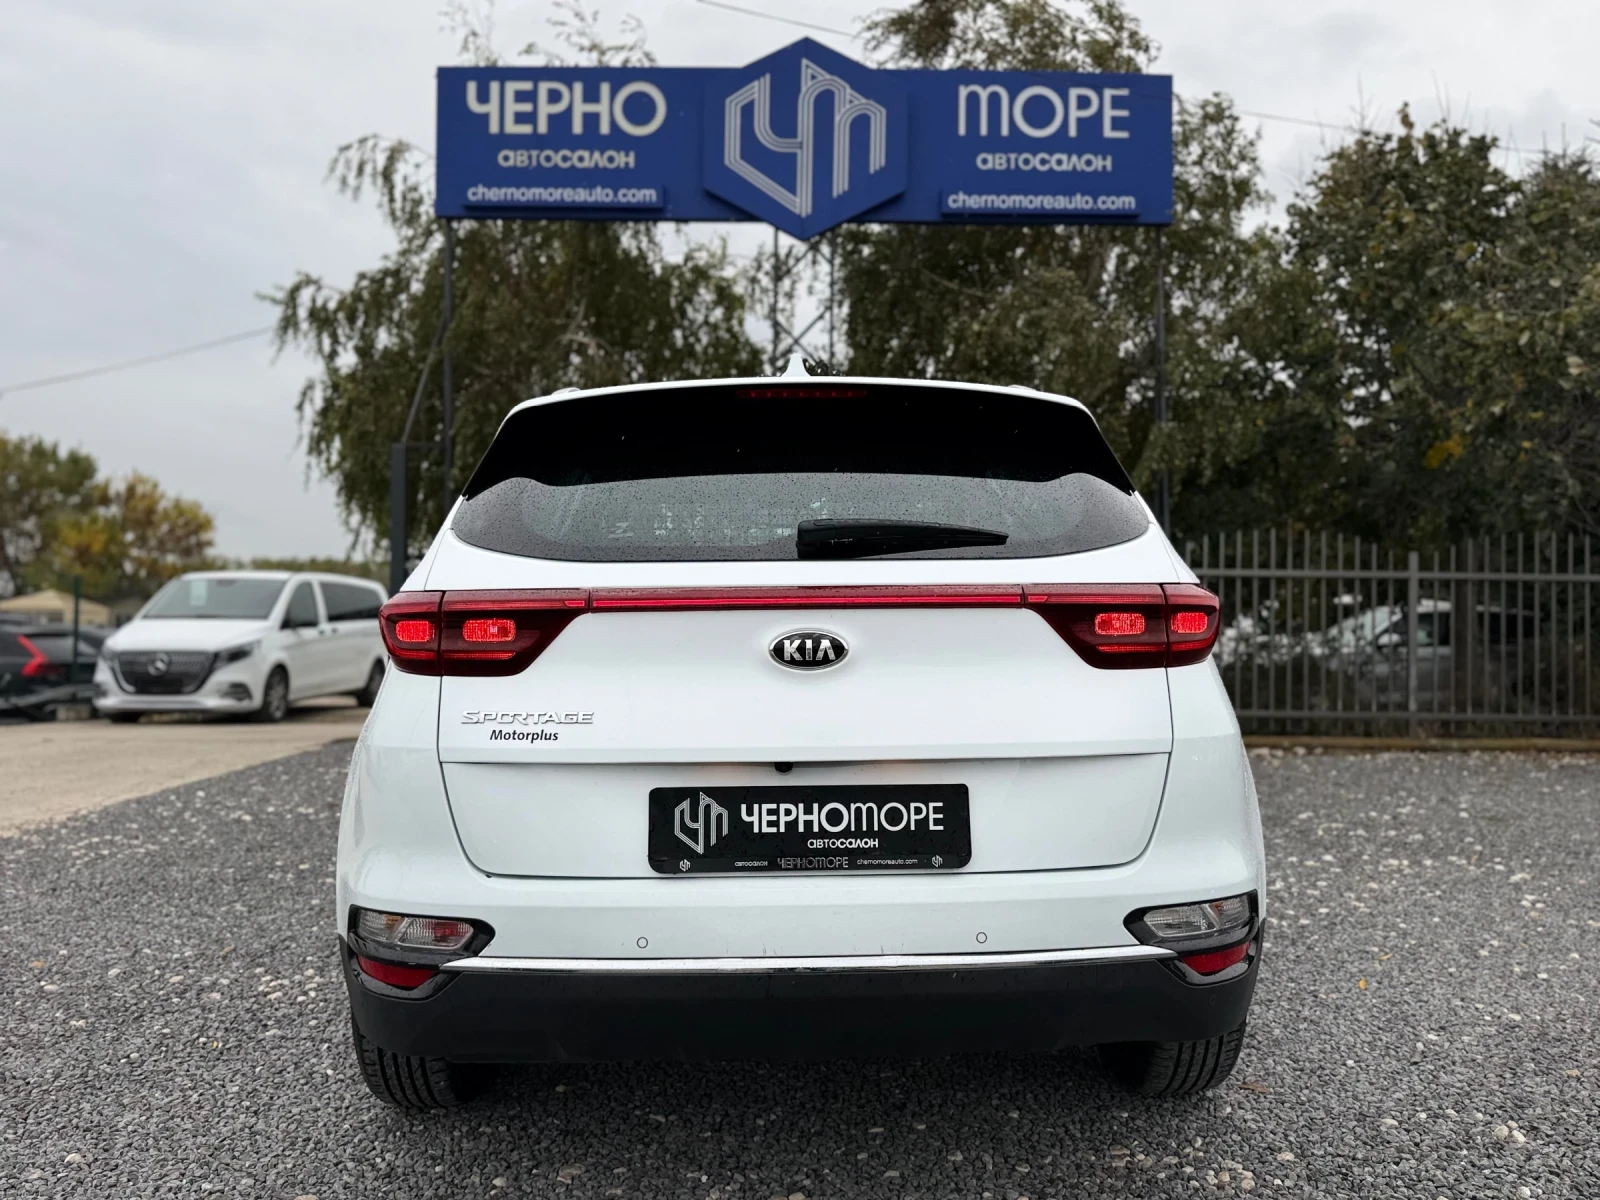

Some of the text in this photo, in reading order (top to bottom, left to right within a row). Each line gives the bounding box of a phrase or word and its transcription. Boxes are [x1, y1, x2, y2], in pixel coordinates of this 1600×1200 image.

[466, 80, 667, 137] ЧЕРНО
[958, 84, 1131, 139] МОРЕ
[497, 149, 635, 169] автосалон
[976, 152, 1113, 172] автосалон
[467, 184, 657, 203] chernomoreauto.com
[947, 190, 1136, 210] chernomoreauto.com
[782, 639, 837, 661] KIA
[461, 710, 595, 725] SPORTAGE
[489, 729, 559, 744] Motorplus
[740, 801, 945, 834] ЧЕРНОМОРЕ
[807, 838, 879, 849] автосалон
[777, 857, 849, 869] ЧЕРНОМОРЕ
